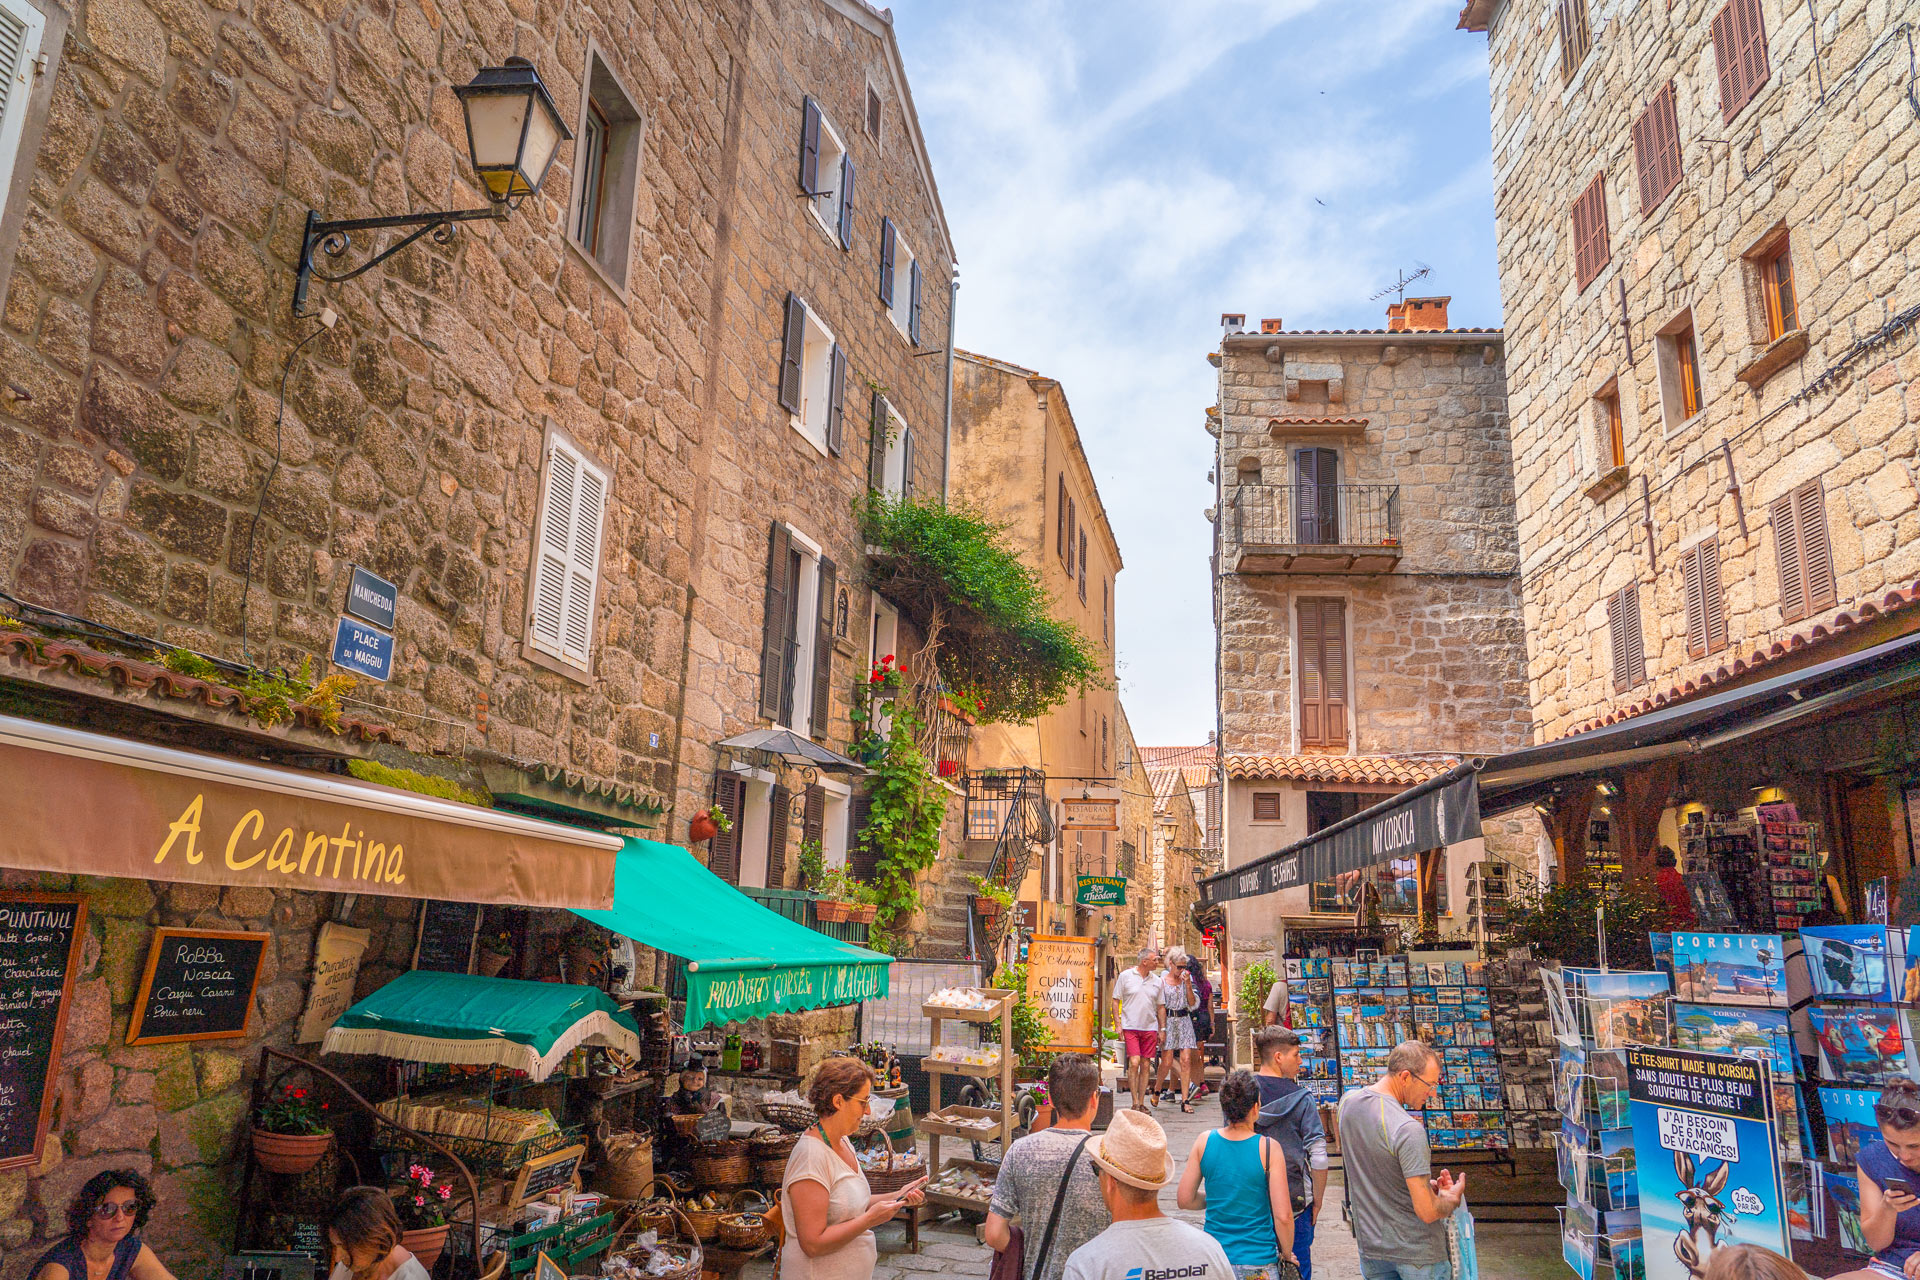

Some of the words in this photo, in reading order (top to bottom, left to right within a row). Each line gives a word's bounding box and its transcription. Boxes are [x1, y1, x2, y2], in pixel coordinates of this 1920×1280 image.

[354, 583, 393, 613] MANICHEDDA
[353, 630, 380, 650] PLACE
[343, 649, 352, 658] DU
[354, 649, 383, 669] MAGGIU
[1068, 805, 1112, 813] RESTAURANT
[1373, 821, 1383, 855] MY
[1384, 809, 1415, 851] CORSICA
[154, 794, 204, 865] A
[225, 809, 406, 885] Cantina
[1078, 877, 1125, 889] RESTAURANT
[1039, 944, 1086, 954] RESTAURANT
[1677, 936, 1775, 949] CORSICA
[5, 966, 63, 978] Charcuterie
[705, 976, 771, 1009] PRODUITS
[774, 970, 813, 1000] CORSES
[834, 964, 882, 1000] MAGGIU
[1039, 976, 1083, 989] CUISINE
[12, 988, 24, 999] de
[1033, 990, 1087, 1004] FAMILIALE
[1041, 1007, 1078, 1020] CORSE
[1713, 1010, 1747, 1018] CORSICA
[1857, 1013, 1876, 1021] Corse
[1629, 1051, 1639, 1065] LE
[1640, 1053, 1679, 1070] TEE-SHIRT
[1681, 1059, 1705, 1074] MADE
[1707, 1062, 1716, 1075] IN
[1718, 1063, 1756, 1080] CORSICA
[1635, 1068, 1656, 1083] SANS
[1659, 1071, 1686, 1087] DOUTE
[1688, 1075, 1699, 1089] LE
[1701, 1077, 1724, 1093] PLUS
[1727, 1081, 1751, 1096] BEAU
[1648, 1084, 1689, 1101] SOUVENIR
[1691, 1090, 1703, 1104] DE
[1705, 1092, 1735, 1109] CORSE
[1664, 1111, 1683, 1124] J'AI
[1687, 1115, 1728, 1132] BESOIN
[1672, 1124, 1684, 1137] DE
[1686, 1127, 1693, 1138] 6
[1696, 1129, 1721, 1144] MOIS
[1664, 1134, 1676, 1146] DE
[1678, 1137, 1737, 1158] VACANCES!
[1735, 1192, 1740, 1202] 2
[1741, 1195, 1756, 1205] FOIS
[1737, 1203, 1749, 1211] PAR
